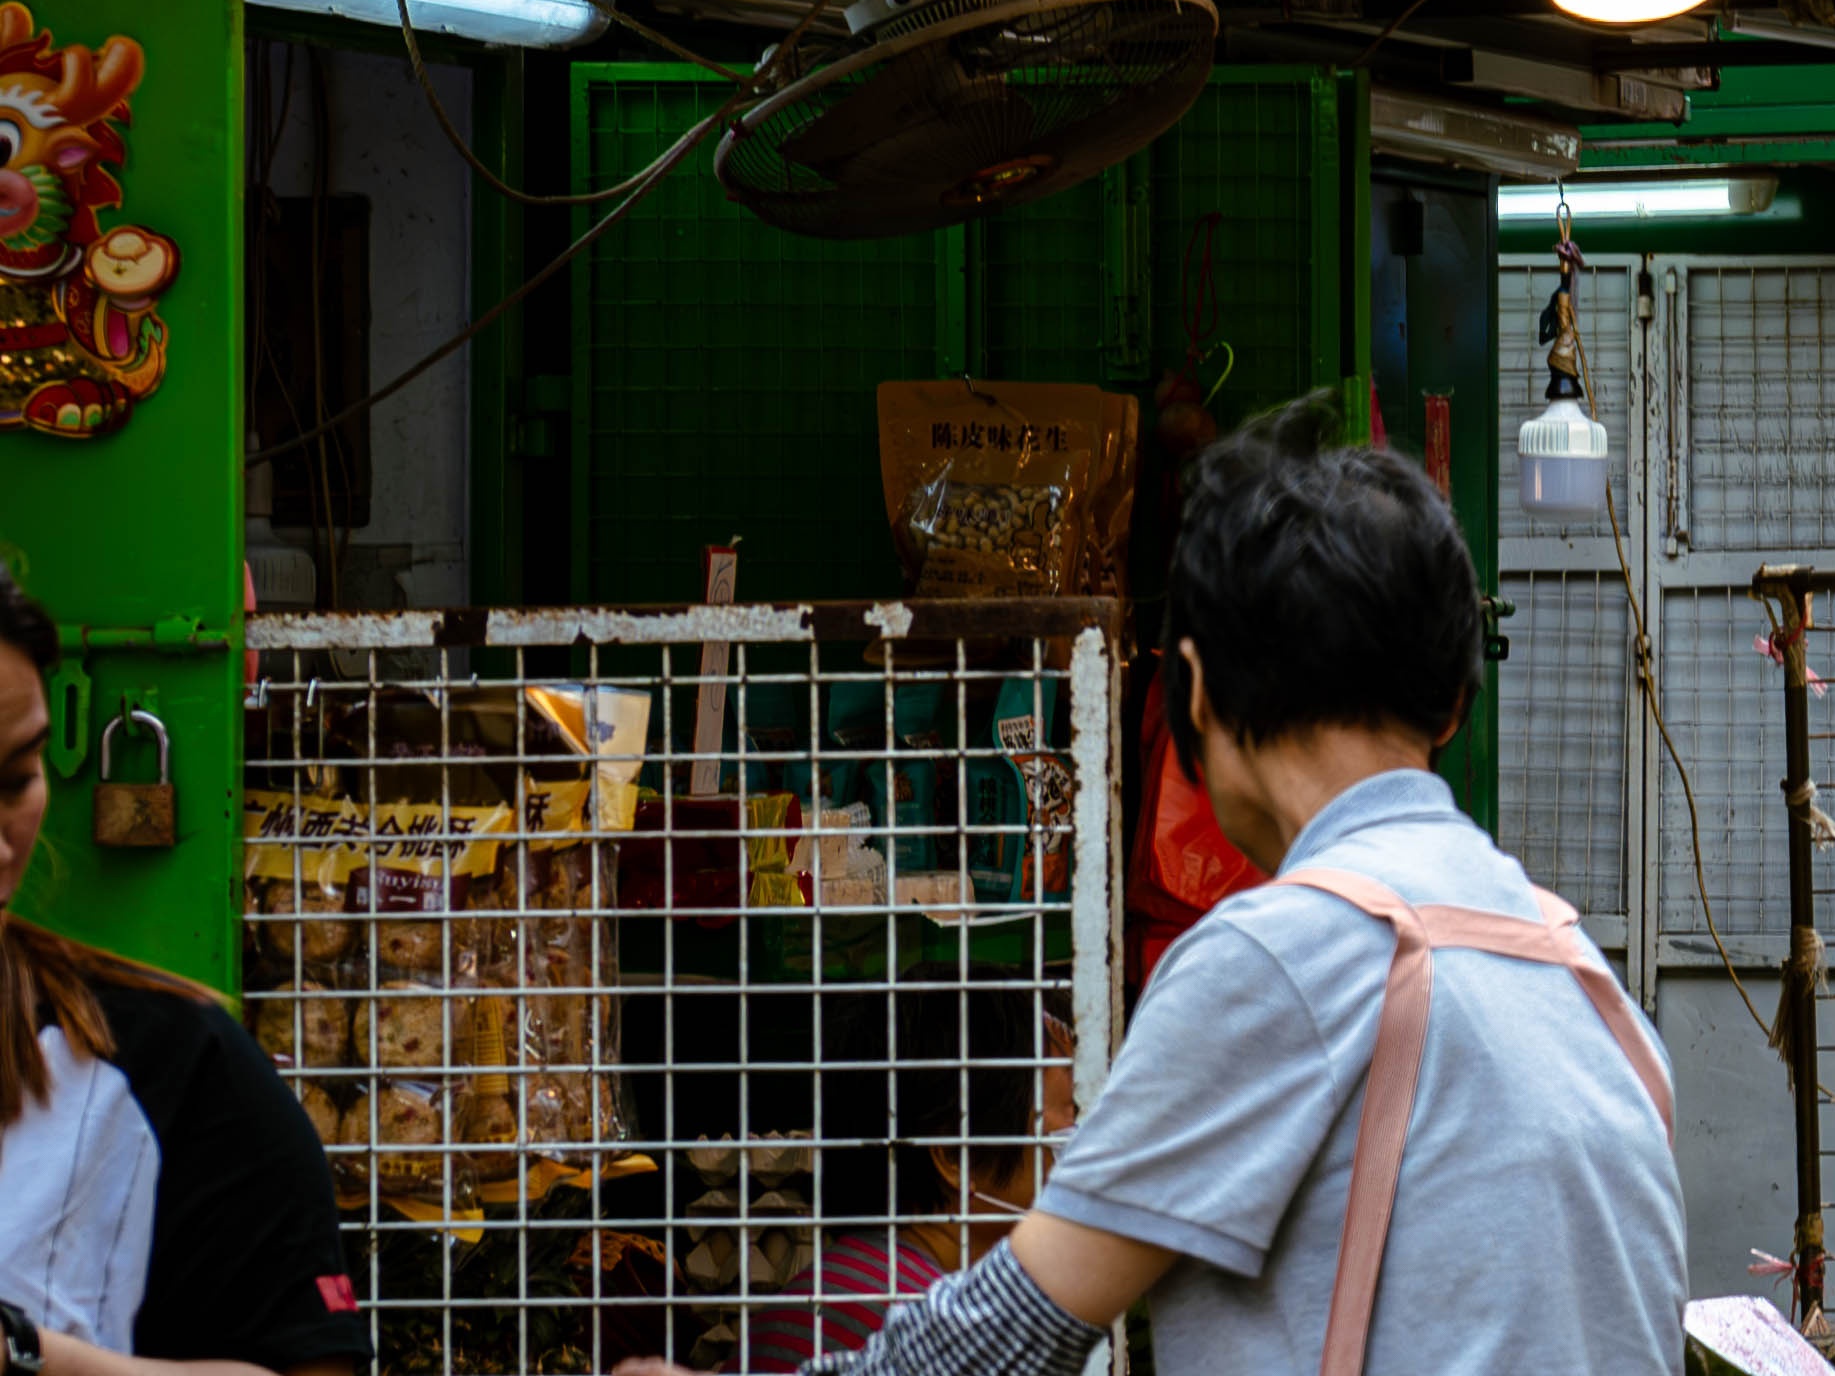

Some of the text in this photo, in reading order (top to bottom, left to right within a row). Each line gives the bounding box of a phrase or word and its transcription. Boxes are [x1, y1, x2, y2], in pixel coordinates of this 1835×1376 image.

[931, 421, 1070, 452] 陈皮味花生
